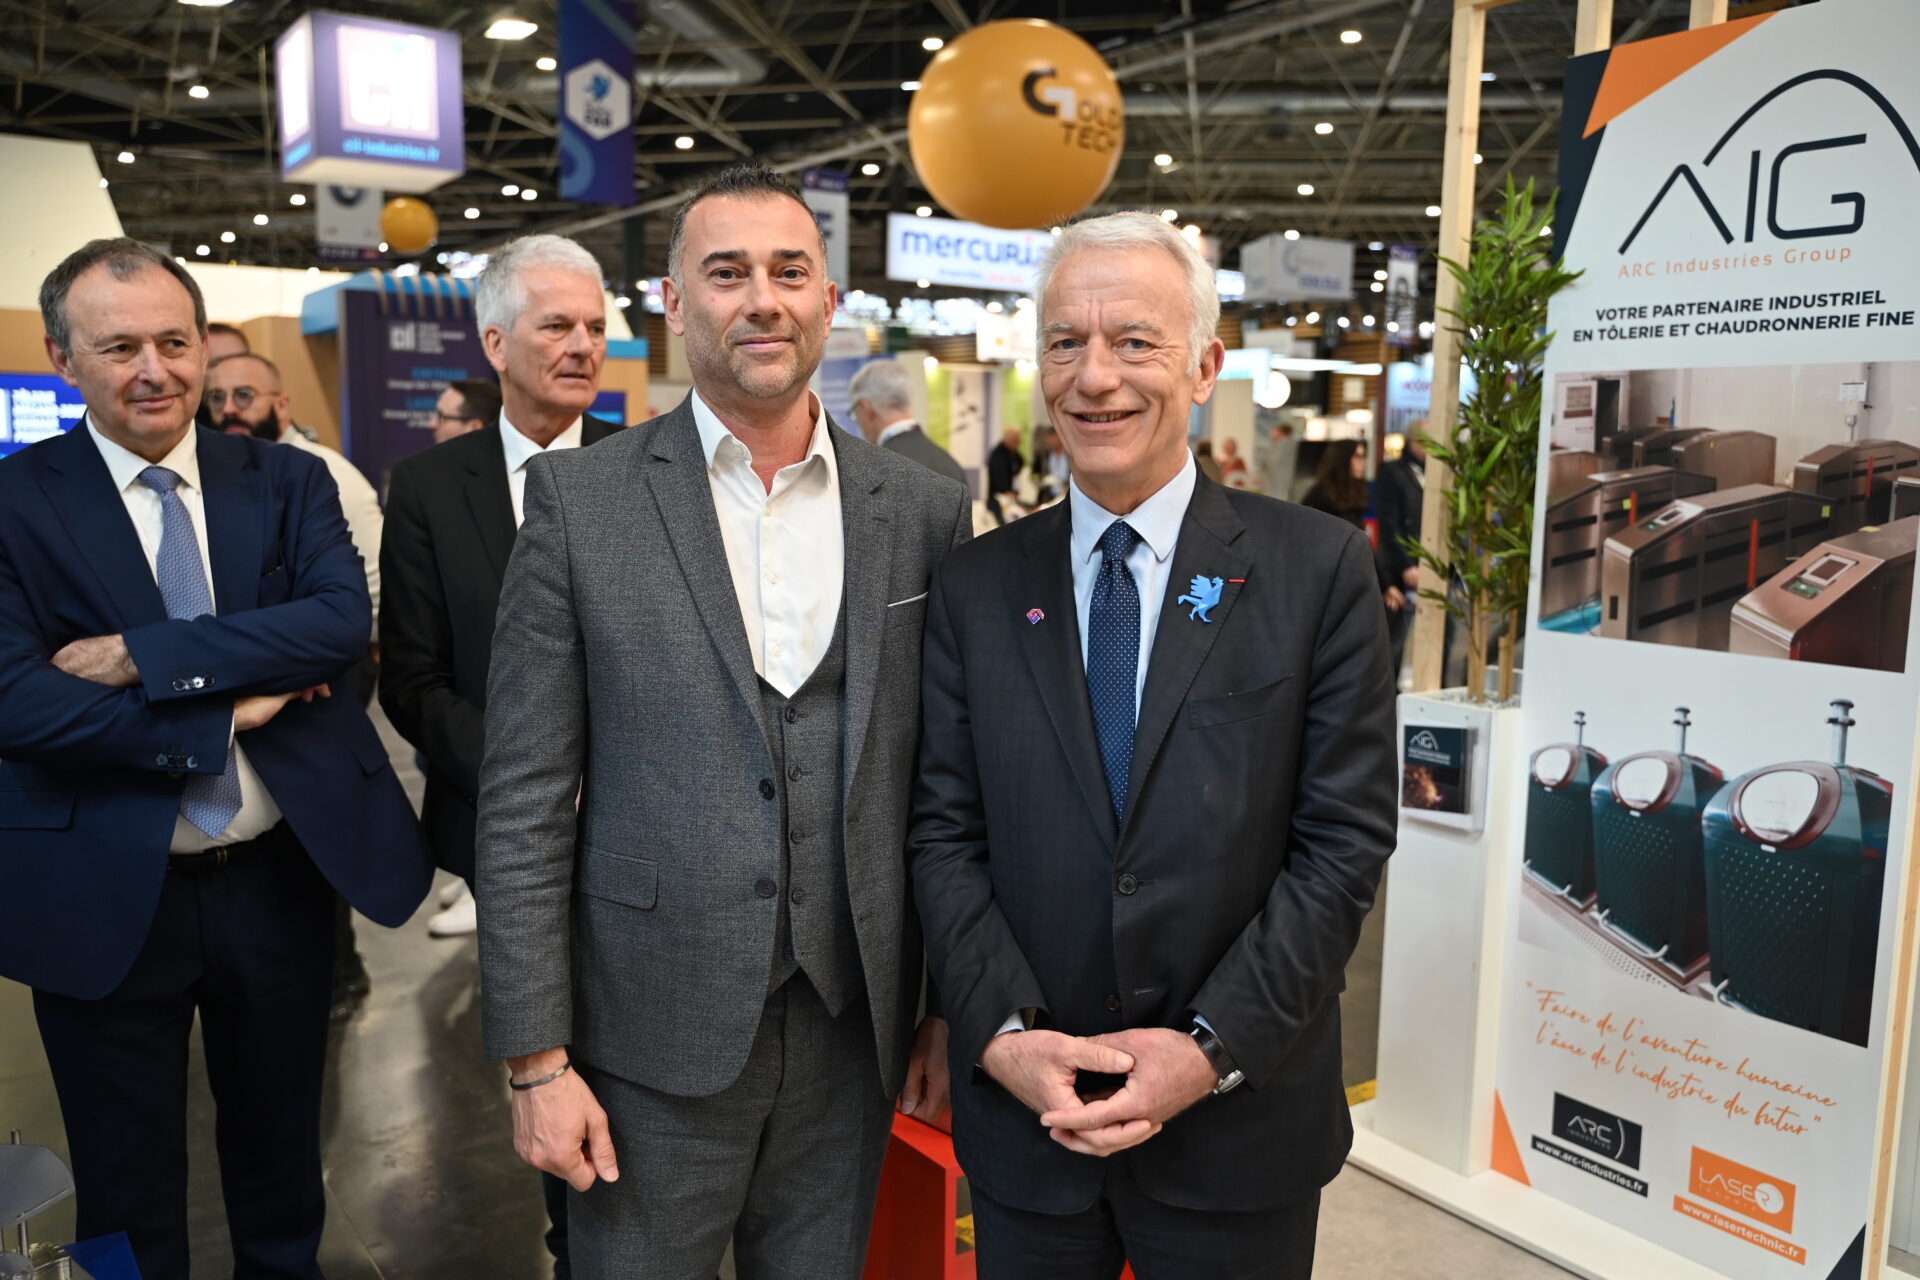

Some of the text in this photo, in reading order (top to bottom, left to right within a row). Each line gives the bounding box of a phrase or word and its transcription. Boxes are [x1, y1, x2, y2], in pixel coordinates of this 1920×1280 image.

[1617, 133, 1867, 255] AIG
[1618, 246, 1852, 278] ARC Industries Group
[1573, 310, 1915, 342] EN TÔLERIE ET CHAUDRONNERIE FINE
[1596, 289, 1886, 321] VOTRE PARTENAIRE INDUSTRIEL
[1591, 1042, 1611, 1070] de
[1615, 1048, 1717, 1104] l'industrie
[1723, 1091, 1750, 1119] du
[1596, 1011, 1617, 1037] de
[1623, 1017, 1728, 1070] l'aventure
[1736, 1057, 1837, 1107] humaine
[1567, 1115, 1612, 1144] ARC
[1535, 1140, 1644, 1193] www.arc-industries.fr
[1681, 1202, 1799, 1258] www.lasertechnic.fr
